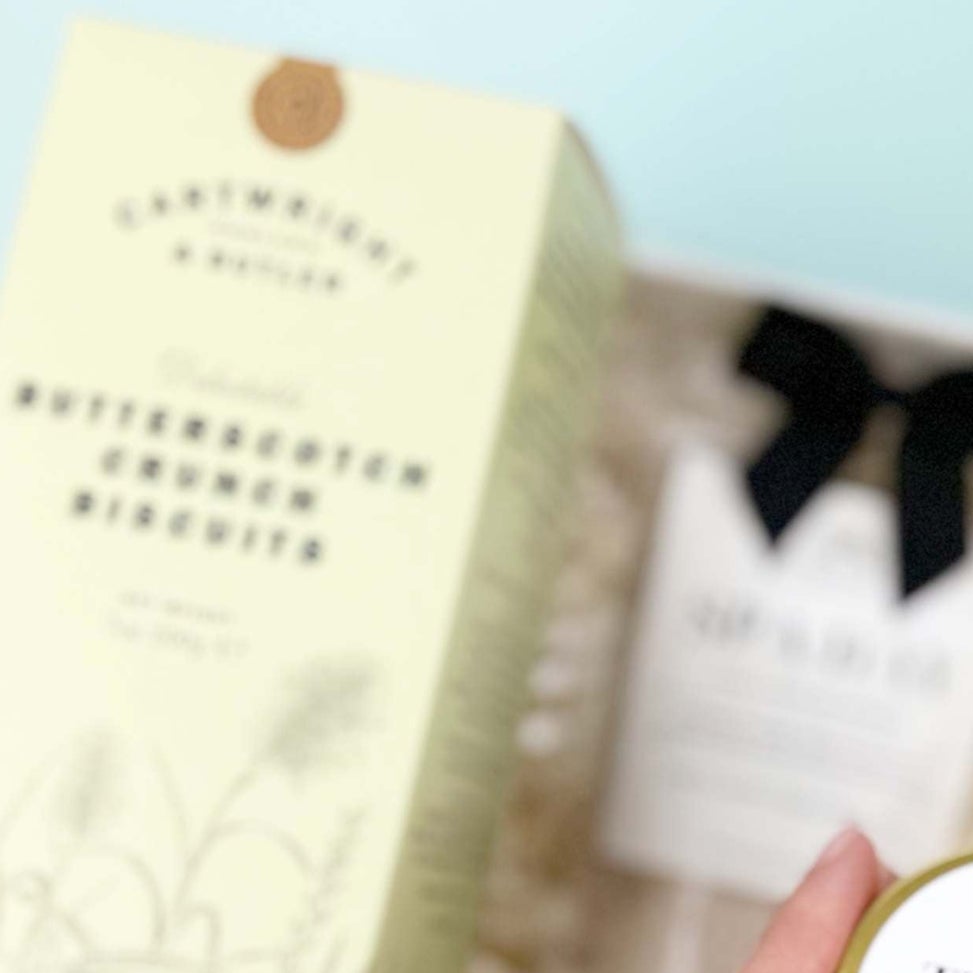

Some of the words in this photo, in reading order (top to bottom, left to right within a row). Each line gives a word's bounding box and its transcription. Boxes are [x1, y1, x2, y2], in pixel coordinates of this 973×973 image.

[113, 176, 420, 284] CARTWRIGHT
[208, 246, 342, 293] BUTLER
[14, 380, 430, 489] BUTTERSCOTCH
[100, 445, 316, 514] CRUNCH
[70, 487, 324, 567] BISCUITS
